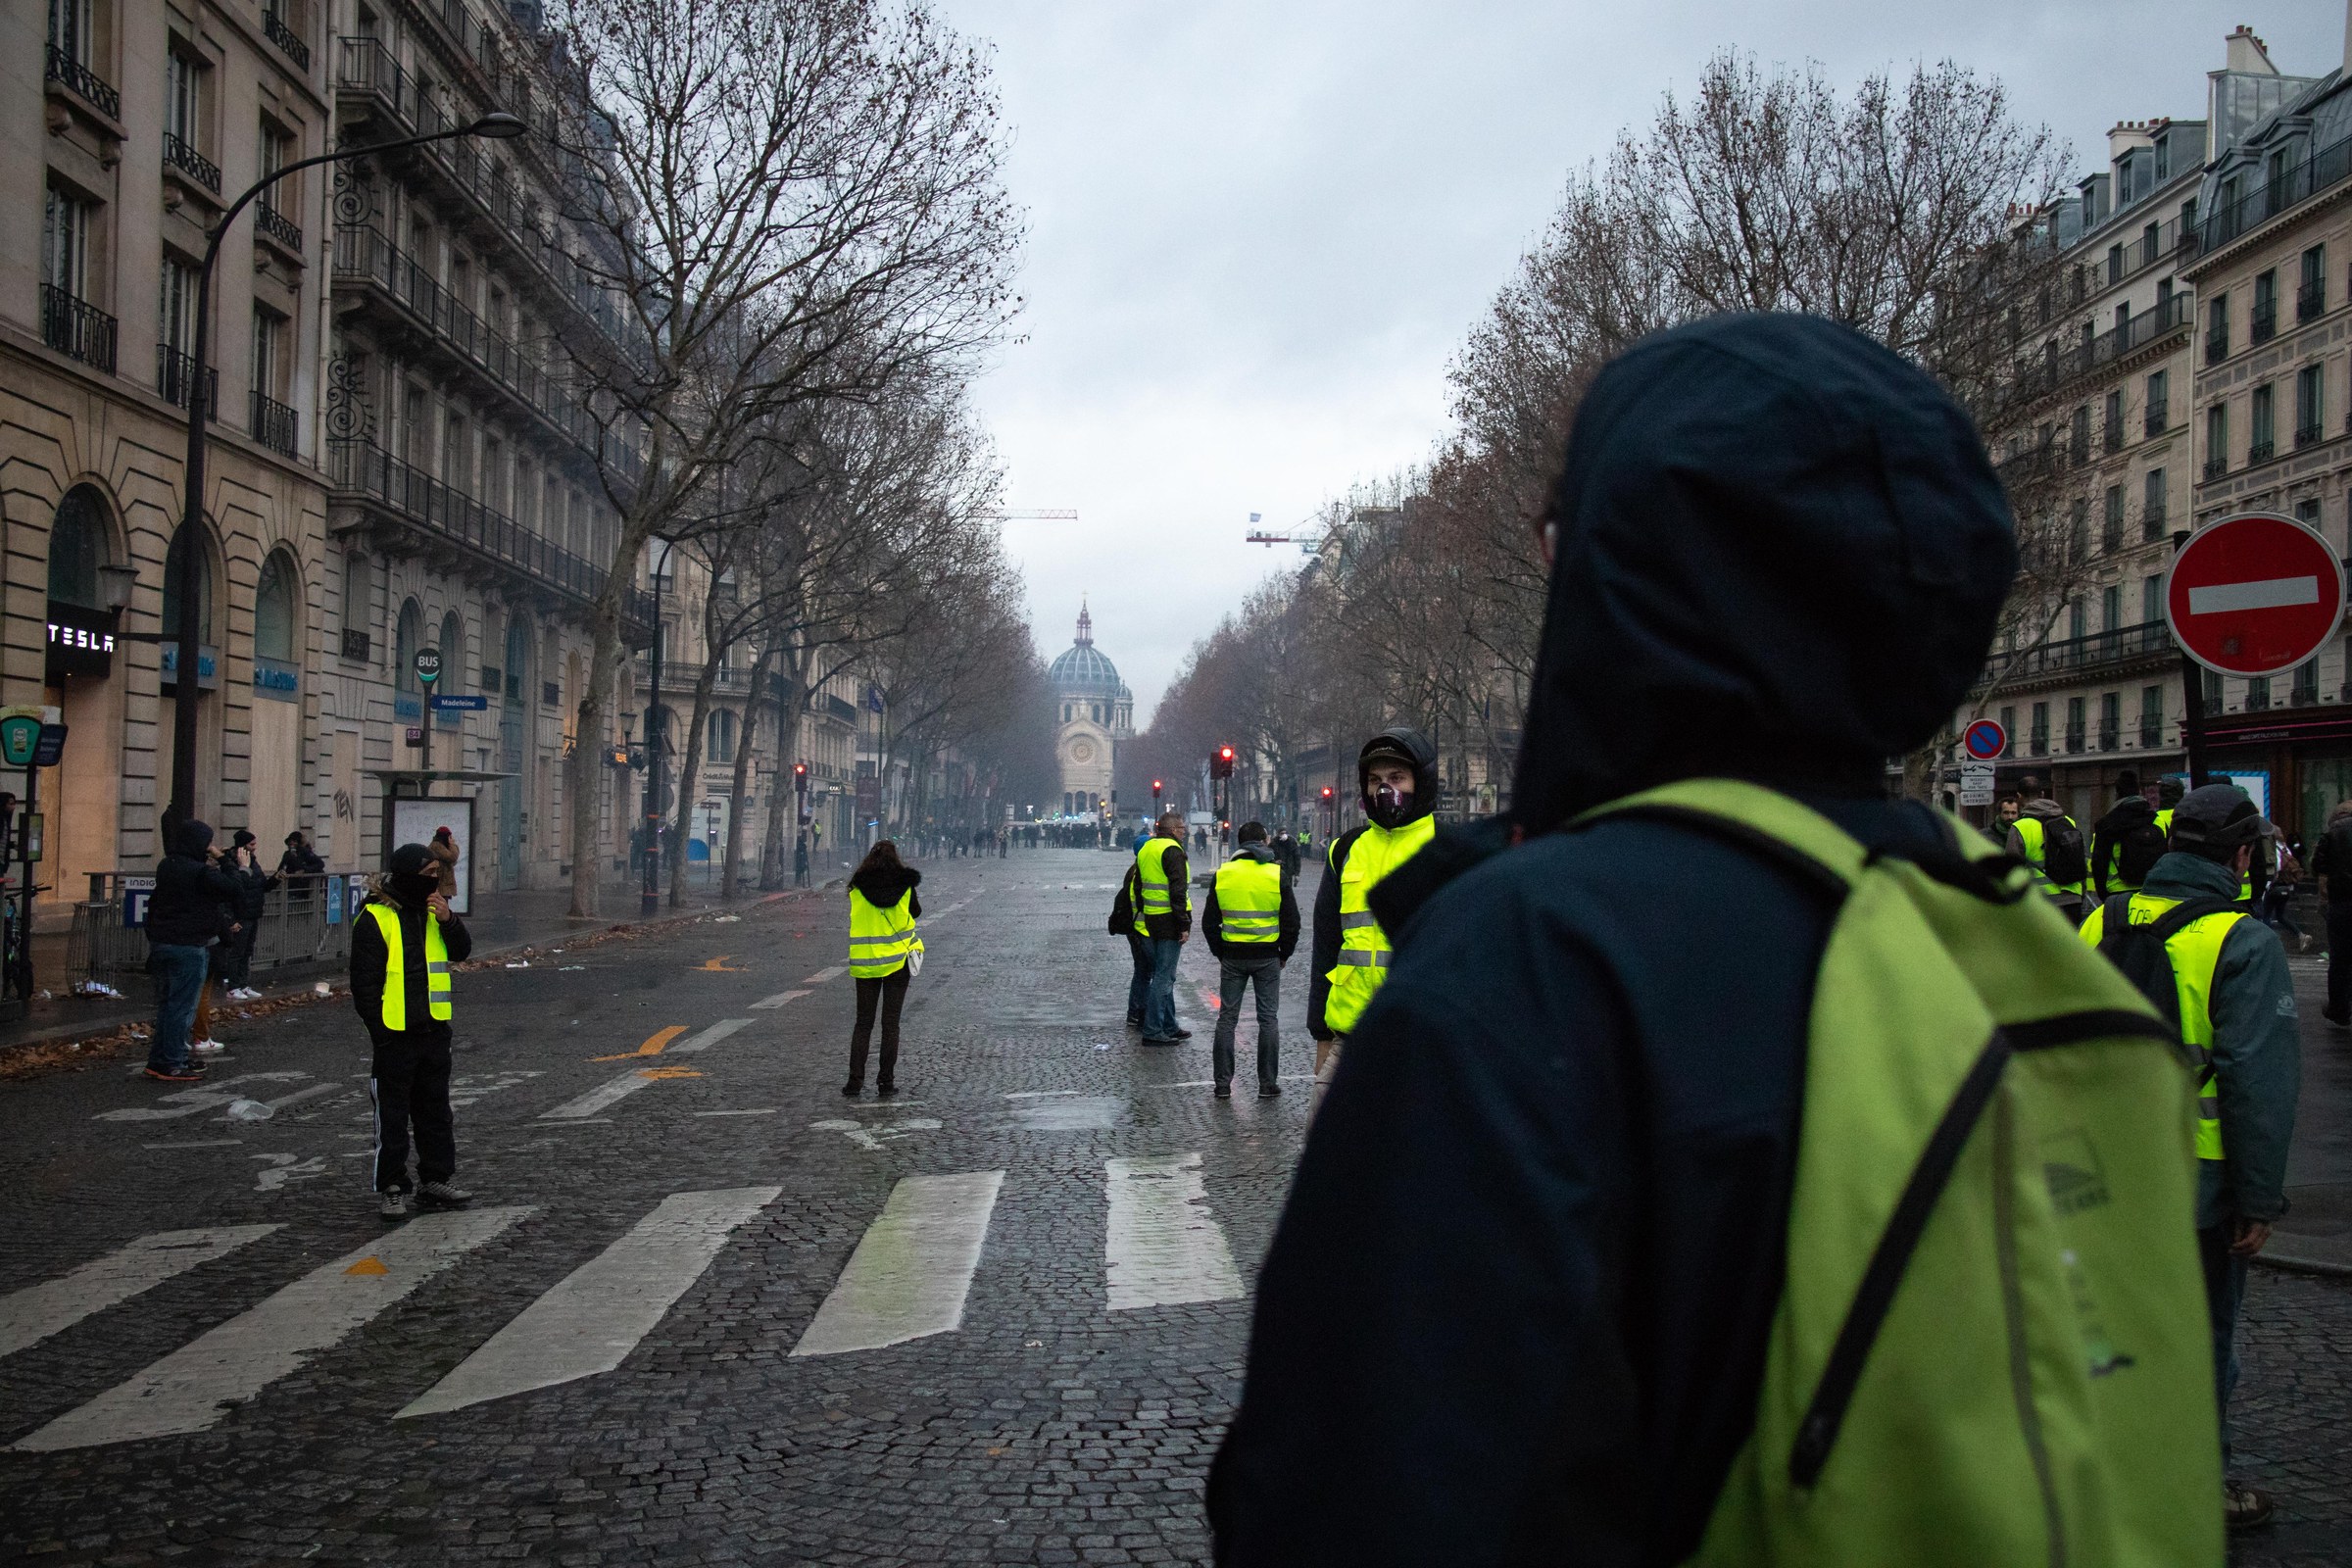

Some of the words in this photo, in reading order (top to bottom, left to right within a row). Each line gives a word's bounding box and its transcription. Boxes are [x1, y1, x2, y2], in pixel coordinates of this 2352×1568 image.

[48, 624, 114, 653] TESLA
[417, 656, 439, 667] BUS
[441, 698, 476, 708] Madeleine
[352, 890, 360, 914] P
